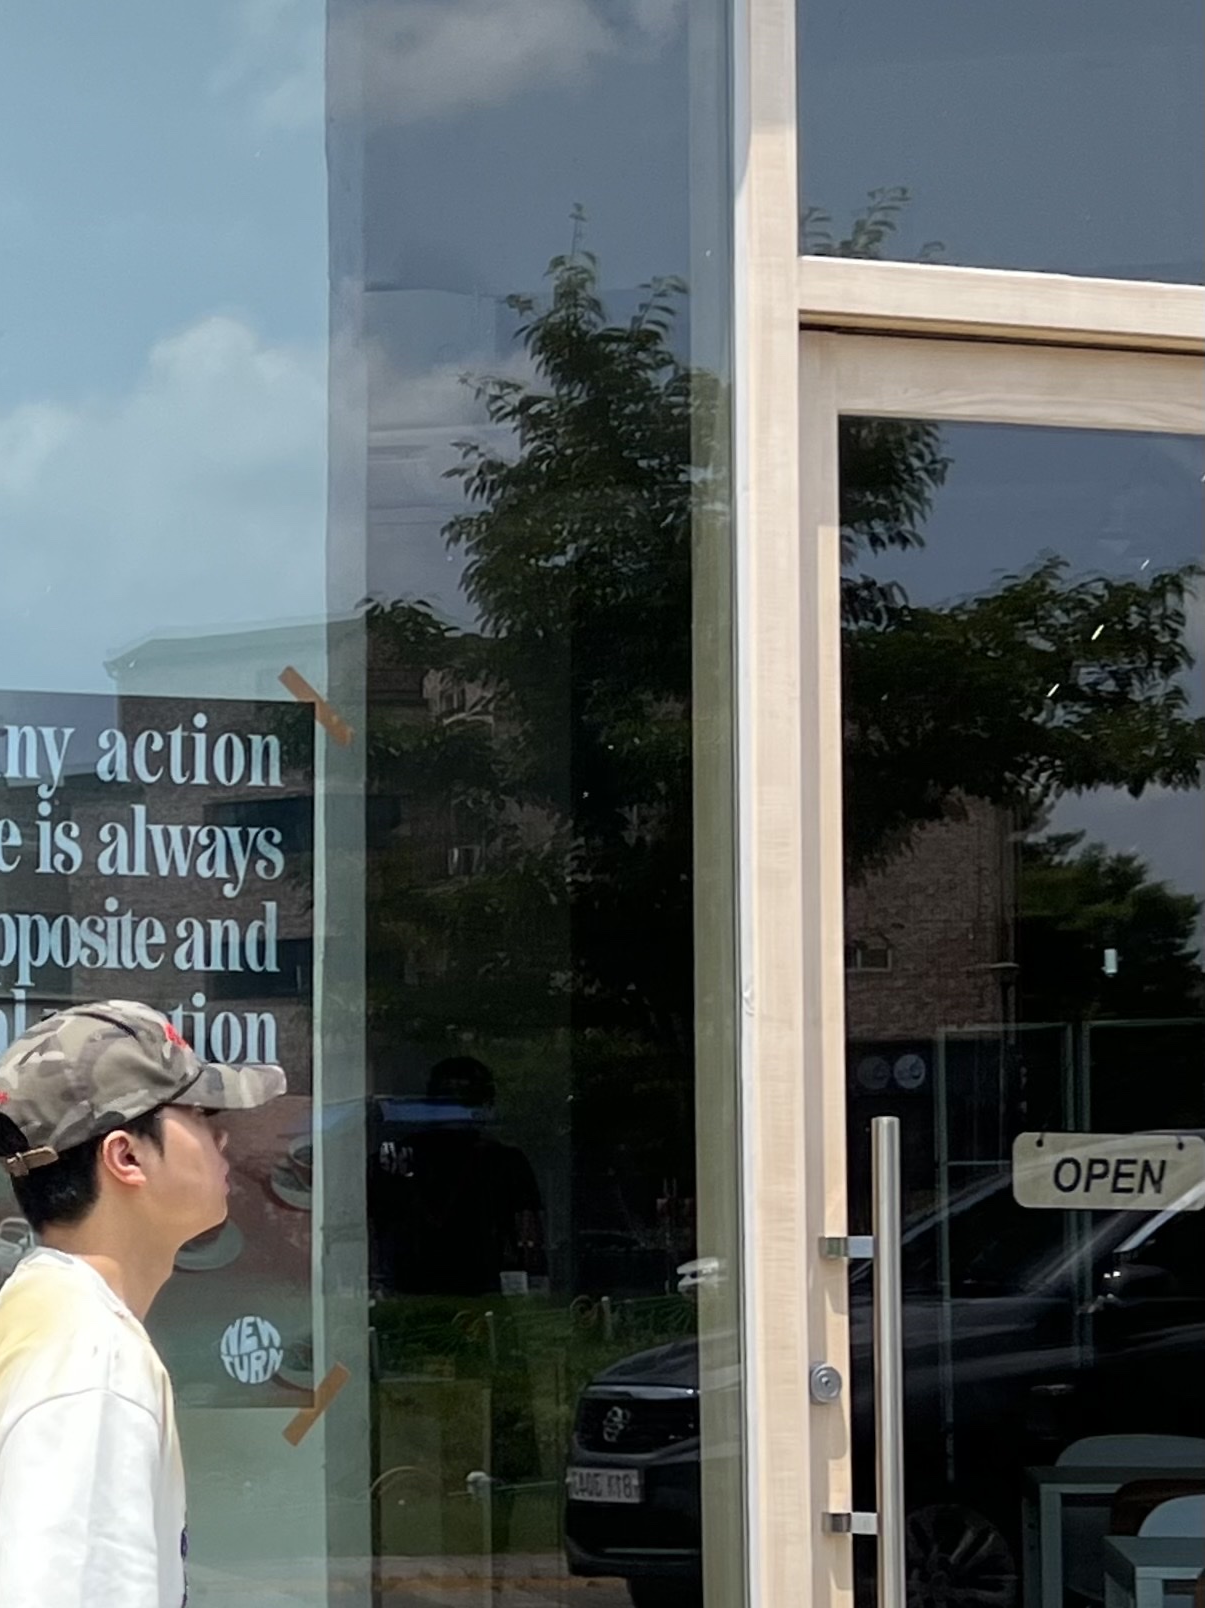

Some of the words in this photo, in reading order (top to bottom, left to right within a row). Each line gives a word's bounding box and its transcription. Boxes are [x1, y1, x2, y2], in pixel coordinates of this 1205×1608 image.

[97, 712, 284, 788] action
[36, 801, 83, 876] is
[97, 804, 284, 898] always
[174, 902, 280, 973] and
[1054, 1157, 1166, 1194] OPEN
[220, 1316, 281, 1356] NEW
[220, 1347, 284, 1384] TURN
